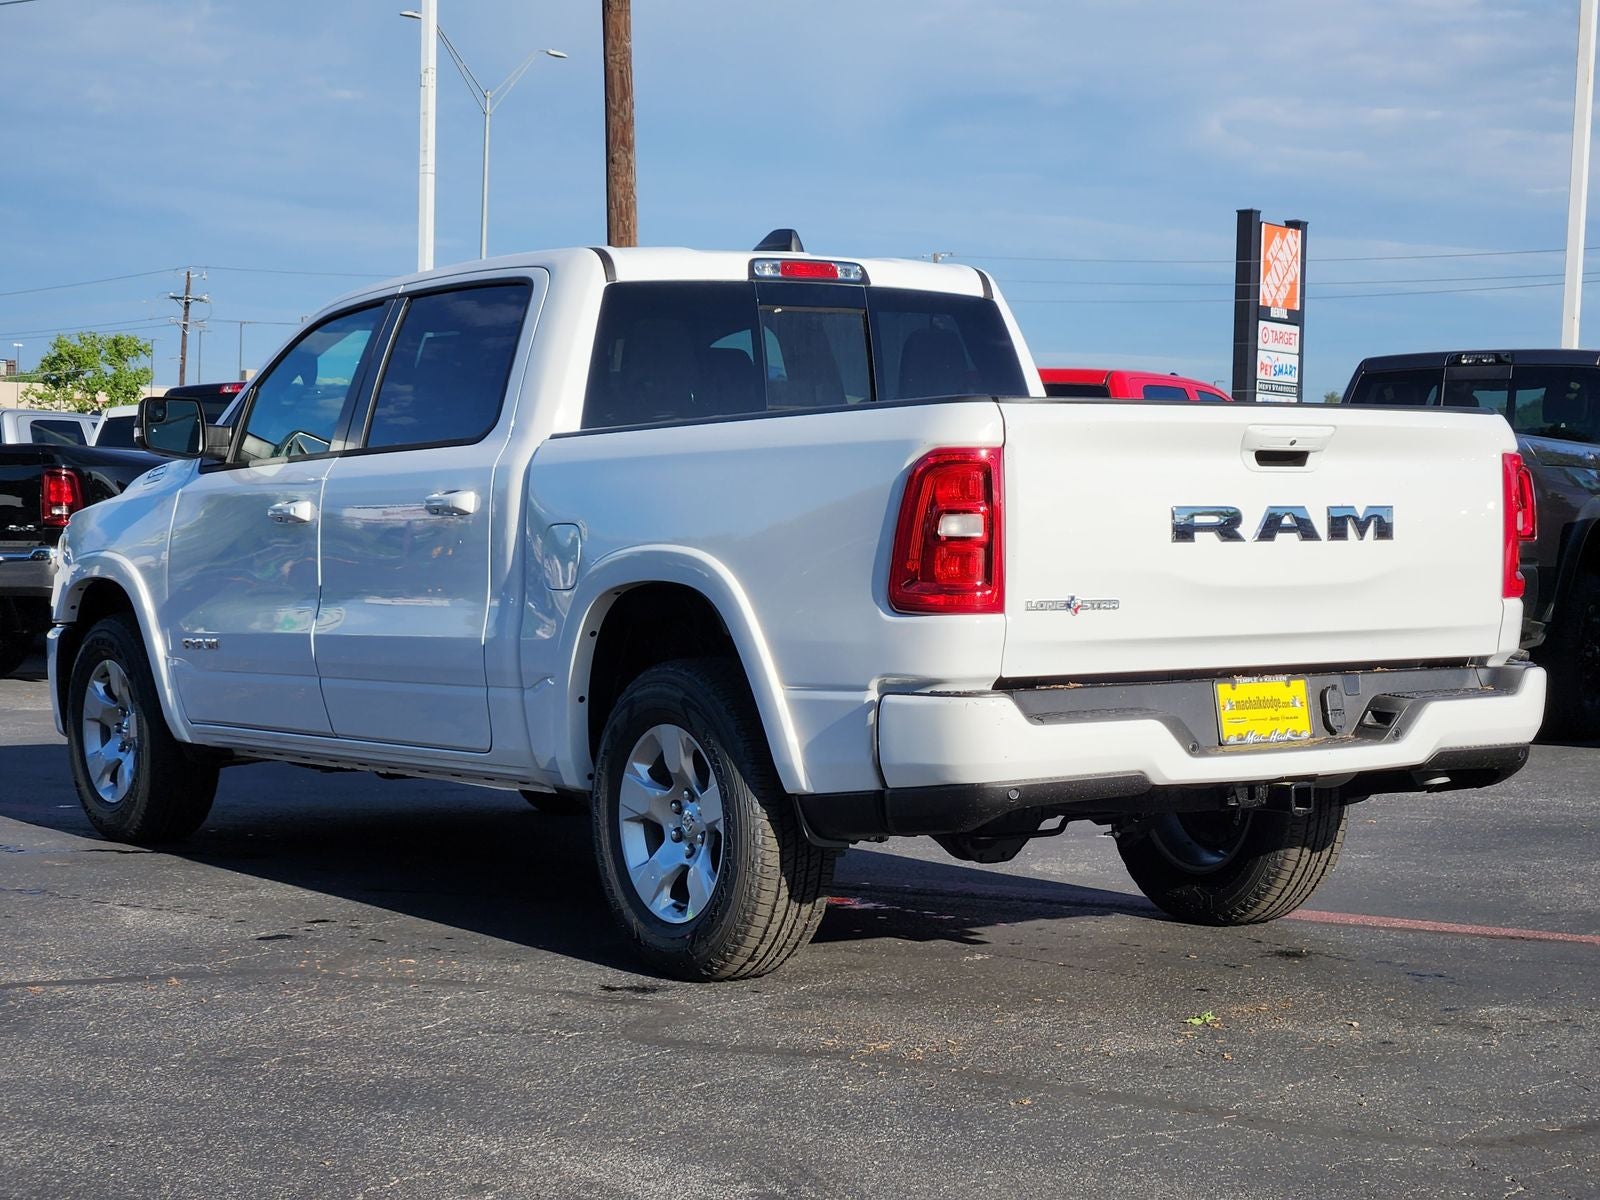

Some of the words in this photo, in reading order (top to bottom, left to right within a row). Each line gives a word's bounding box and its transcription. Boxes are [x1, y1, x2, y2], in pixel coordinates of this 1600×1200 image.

[1270, 329, 1297, 346] TARGET
[1171, 505, 1394, 543] RAM
[1024, 600, 1068, 611] LONE
[1080, 599, 1120, 610] STAR
